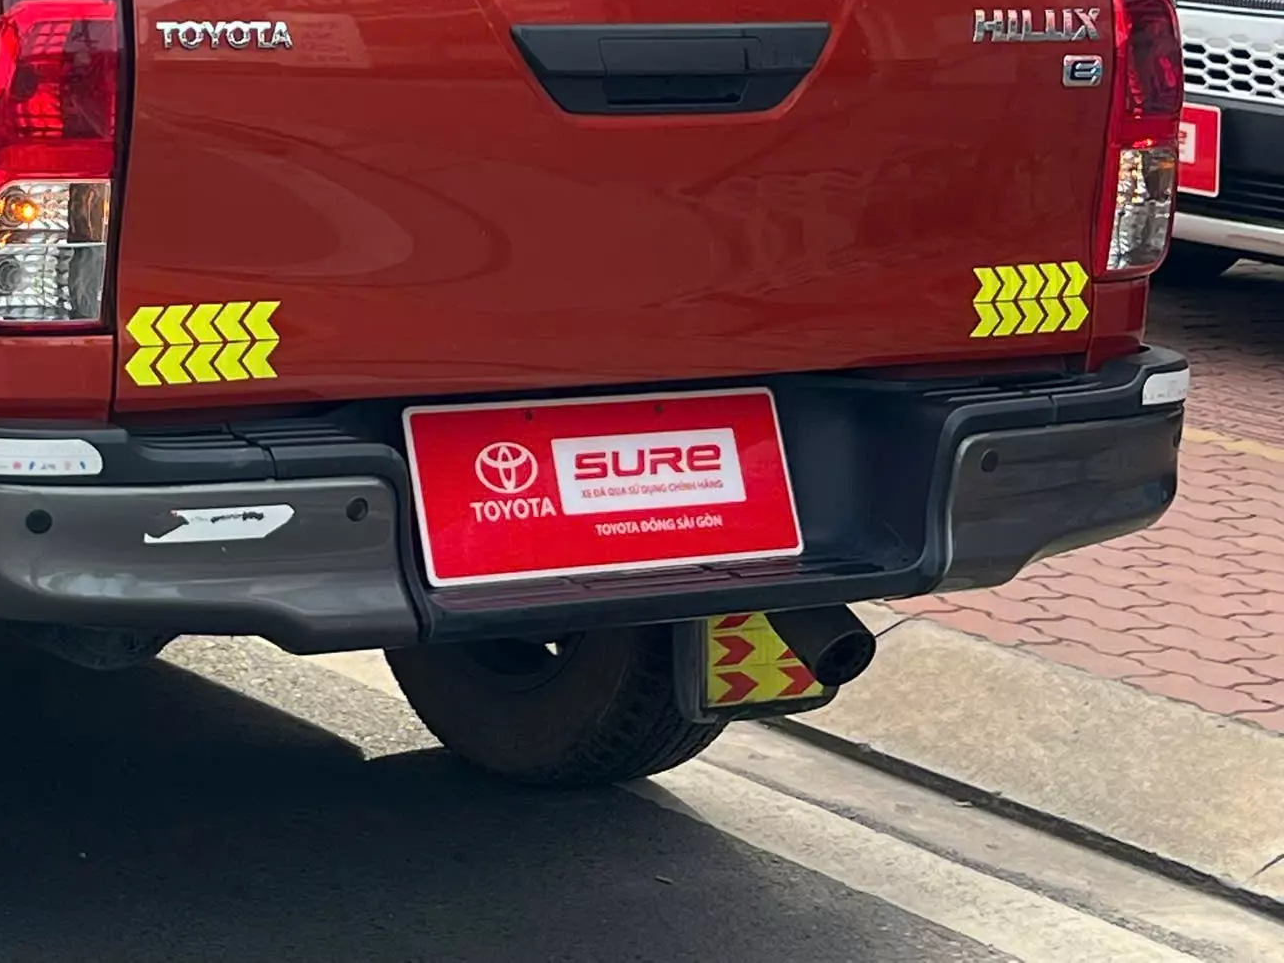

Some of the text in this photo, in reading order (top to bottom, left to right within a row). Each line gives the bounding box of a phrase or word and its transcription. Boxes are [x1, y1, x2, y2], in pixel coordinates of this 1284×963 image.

[156, 21, 293, 49] TOYOTA
[972, 8, 1100, 42] HILUX
[470, 496, 557, 524] TOYOTA
[595, 512, 724, 536] TOYOTA ĐÔNG SÀI GÒN
